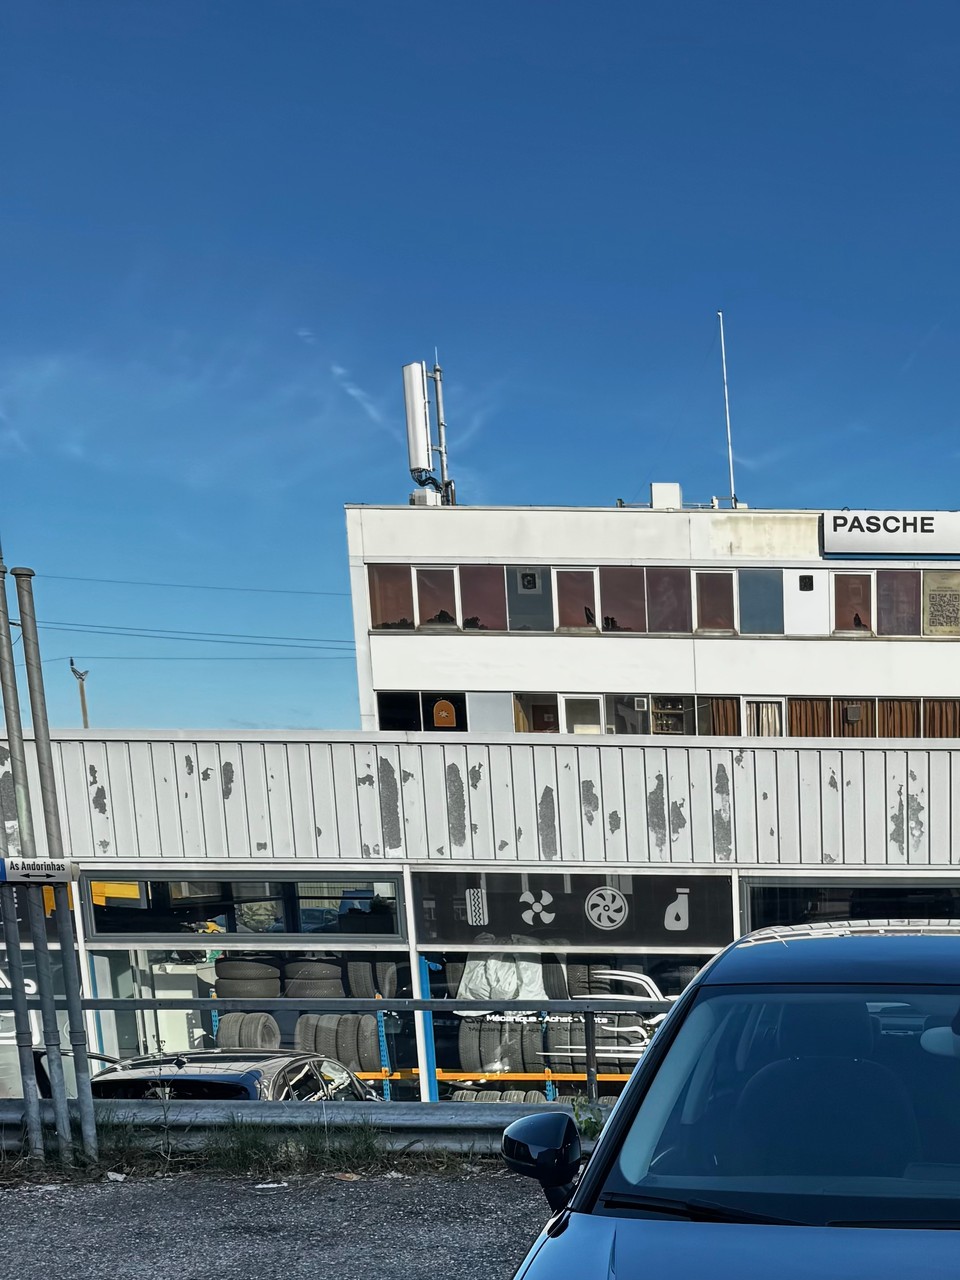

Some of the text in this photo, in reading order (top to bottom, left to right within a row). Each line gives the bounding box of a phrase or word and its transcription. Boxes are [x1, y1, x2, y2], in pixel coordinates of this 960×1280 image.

[833, 516, 935, 533] PASCHE
[9, 861, 66, 871] As Andorinhas
[486, 1014, 537, 1024] Mécanique
[544, 1015, 573, 1023] Achat
[579, 1016, 608, 1024] Vnte
